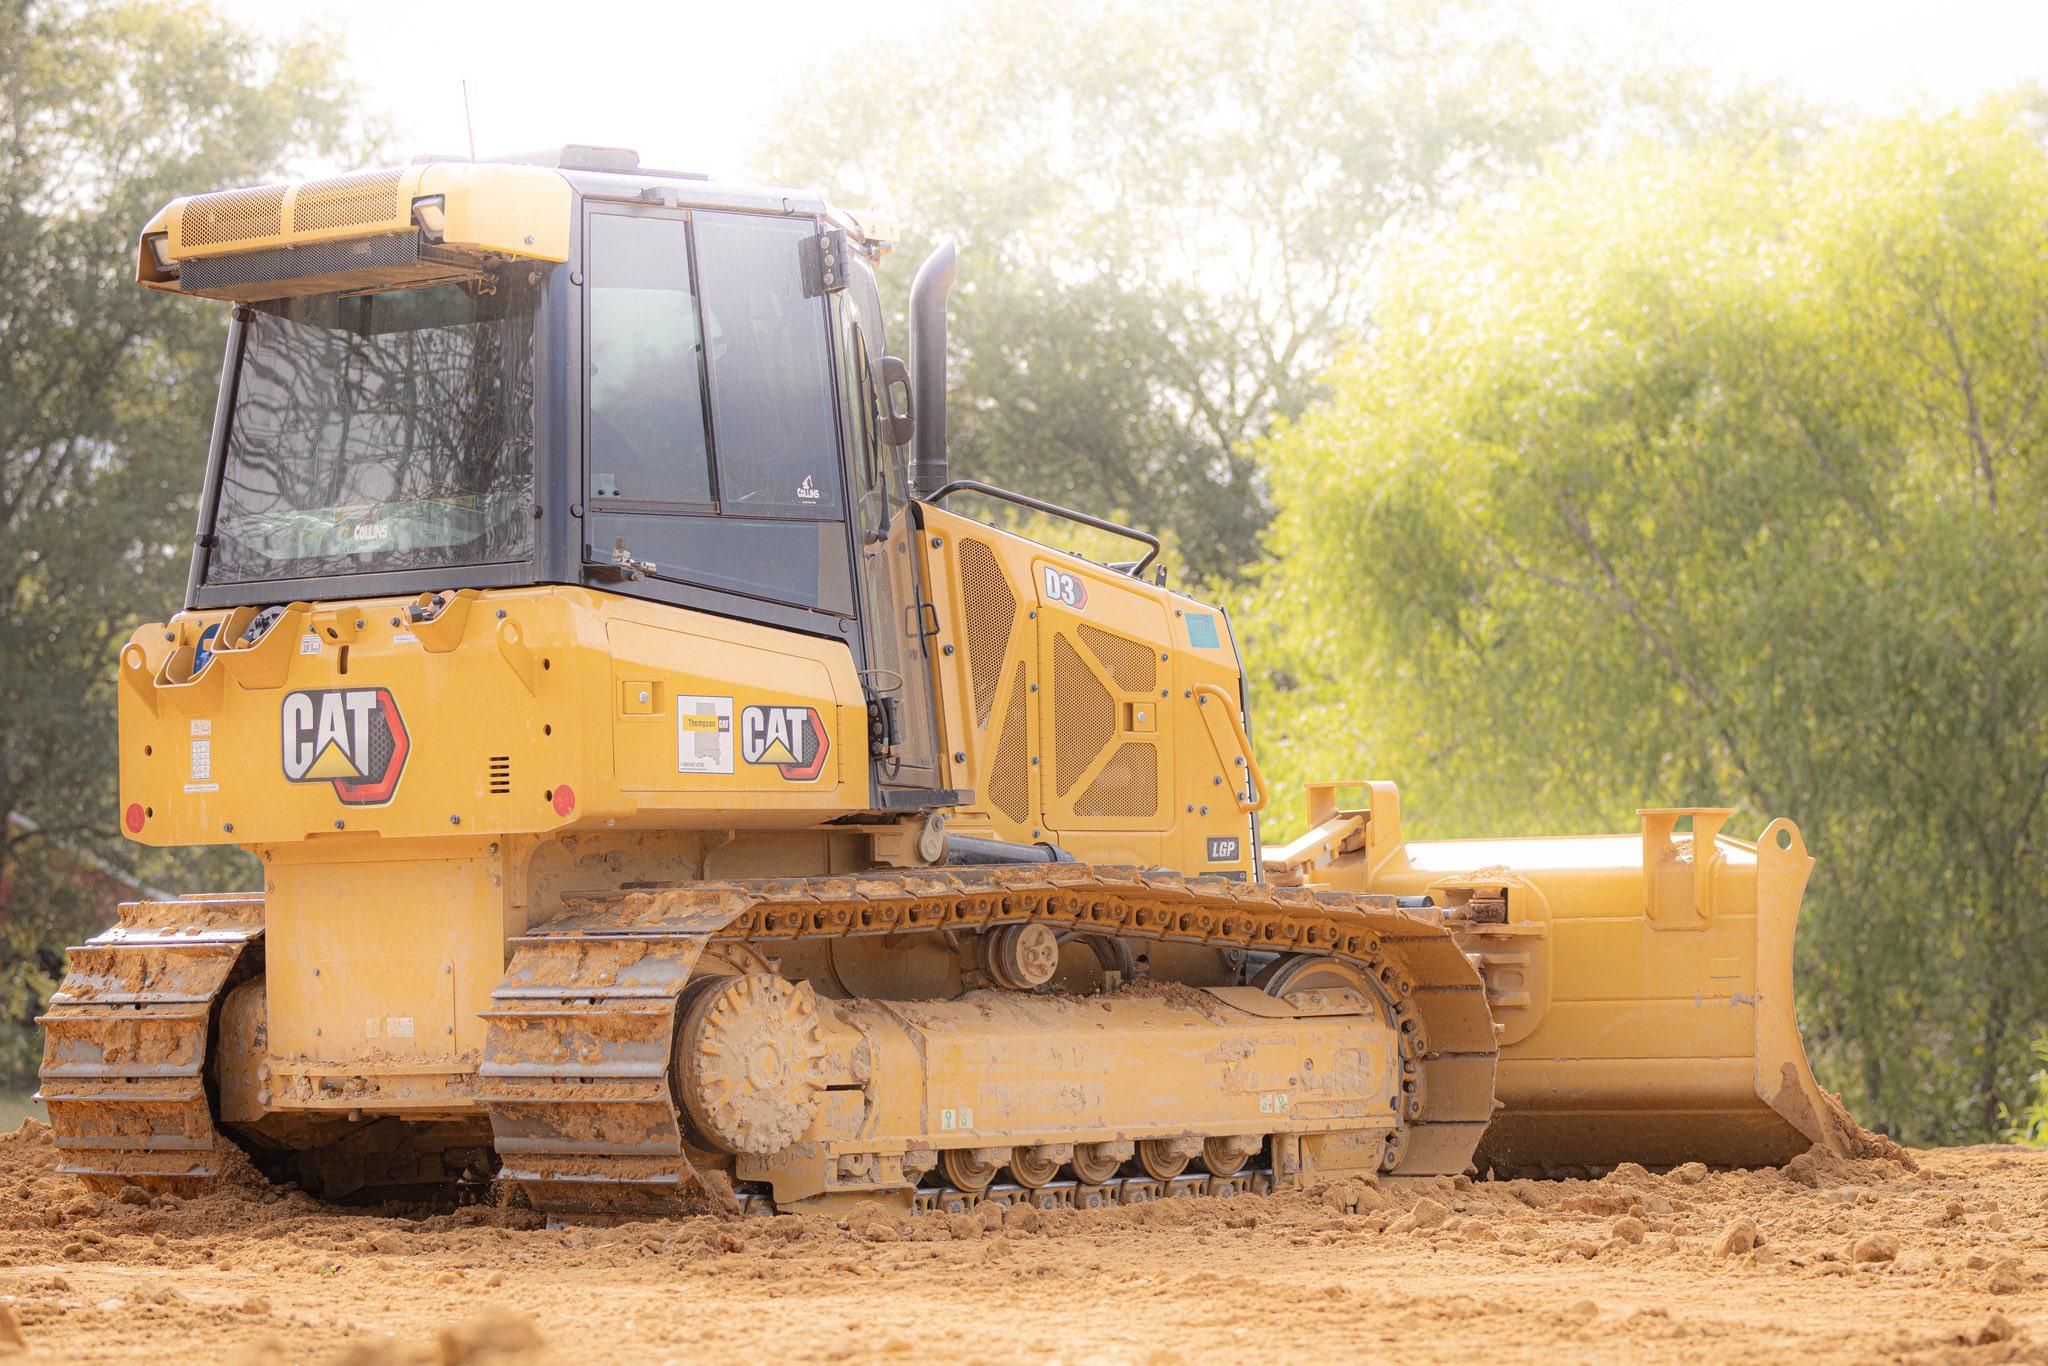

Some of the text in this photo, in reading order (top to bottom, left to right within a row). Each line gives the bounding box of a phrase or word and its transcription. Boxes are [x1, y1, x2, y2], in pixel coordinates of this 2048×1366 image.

[797, 488, 820, 498] COLLINS
[354, 524, 388, 540] COLLINS
[1045, 567, 1075, 605] D3
[688, 718, 729, 729] Thompson CAT
[283, 691, 377, 779] CAT
[742, 706, 808, 763] CAT
[1212, 841, 1235, 857] LGP
